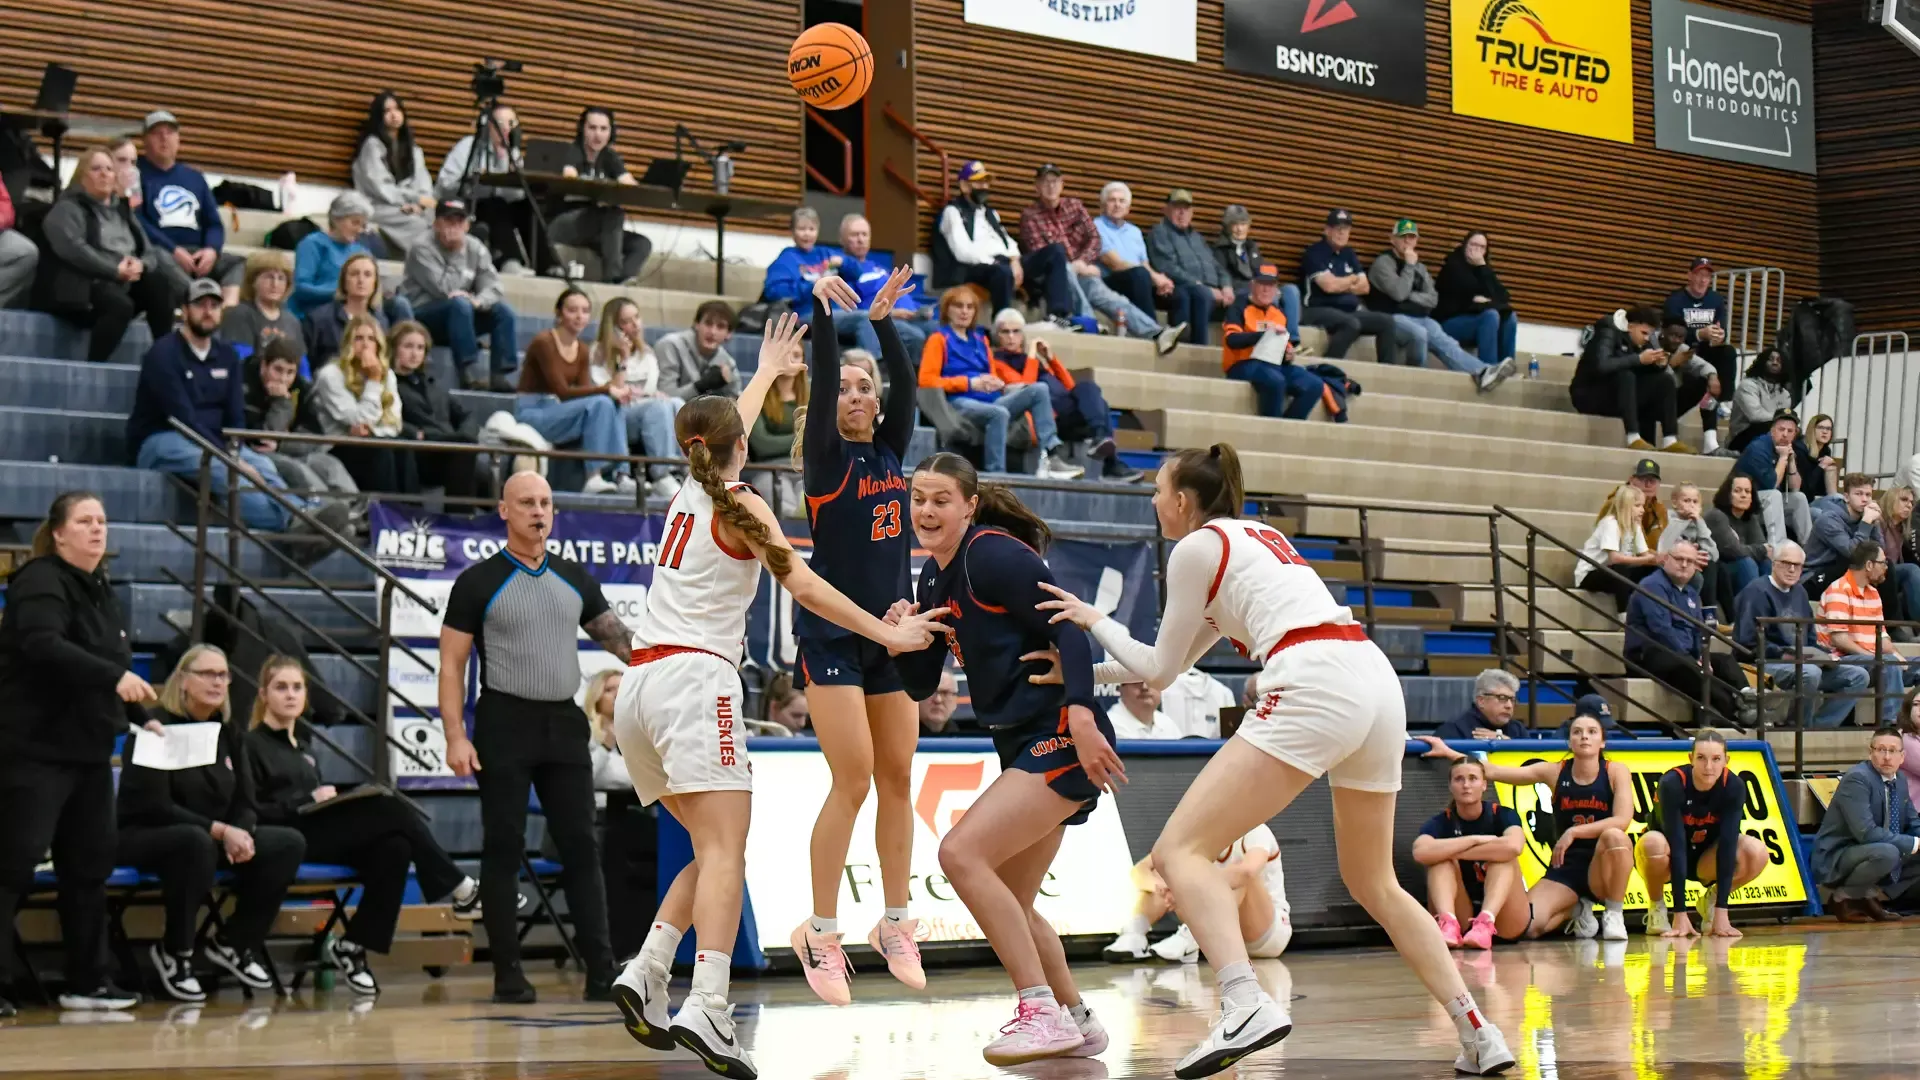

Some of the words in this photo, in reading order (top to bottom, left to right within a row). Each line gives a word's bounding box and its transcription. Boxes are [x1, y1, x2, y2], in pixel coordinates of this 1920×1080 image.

[1476, 35, 1611, 85] TRUSTED
[1667, 46, 1801, 106] Hometown
[1490, 70, 1529, 91] TIRE
[1534, 78, 1544, 94] &
[1549, 82, 1598, 103] AUTO
[1672, 89, 1798, 125] ORTHODONTICS
[658, 511, 695, 570] 11
[871, 499, 902, 541] 23
[716, 695, 736, 767] HUSKIES
[1743, 885, 1788, 900] 323-WING
